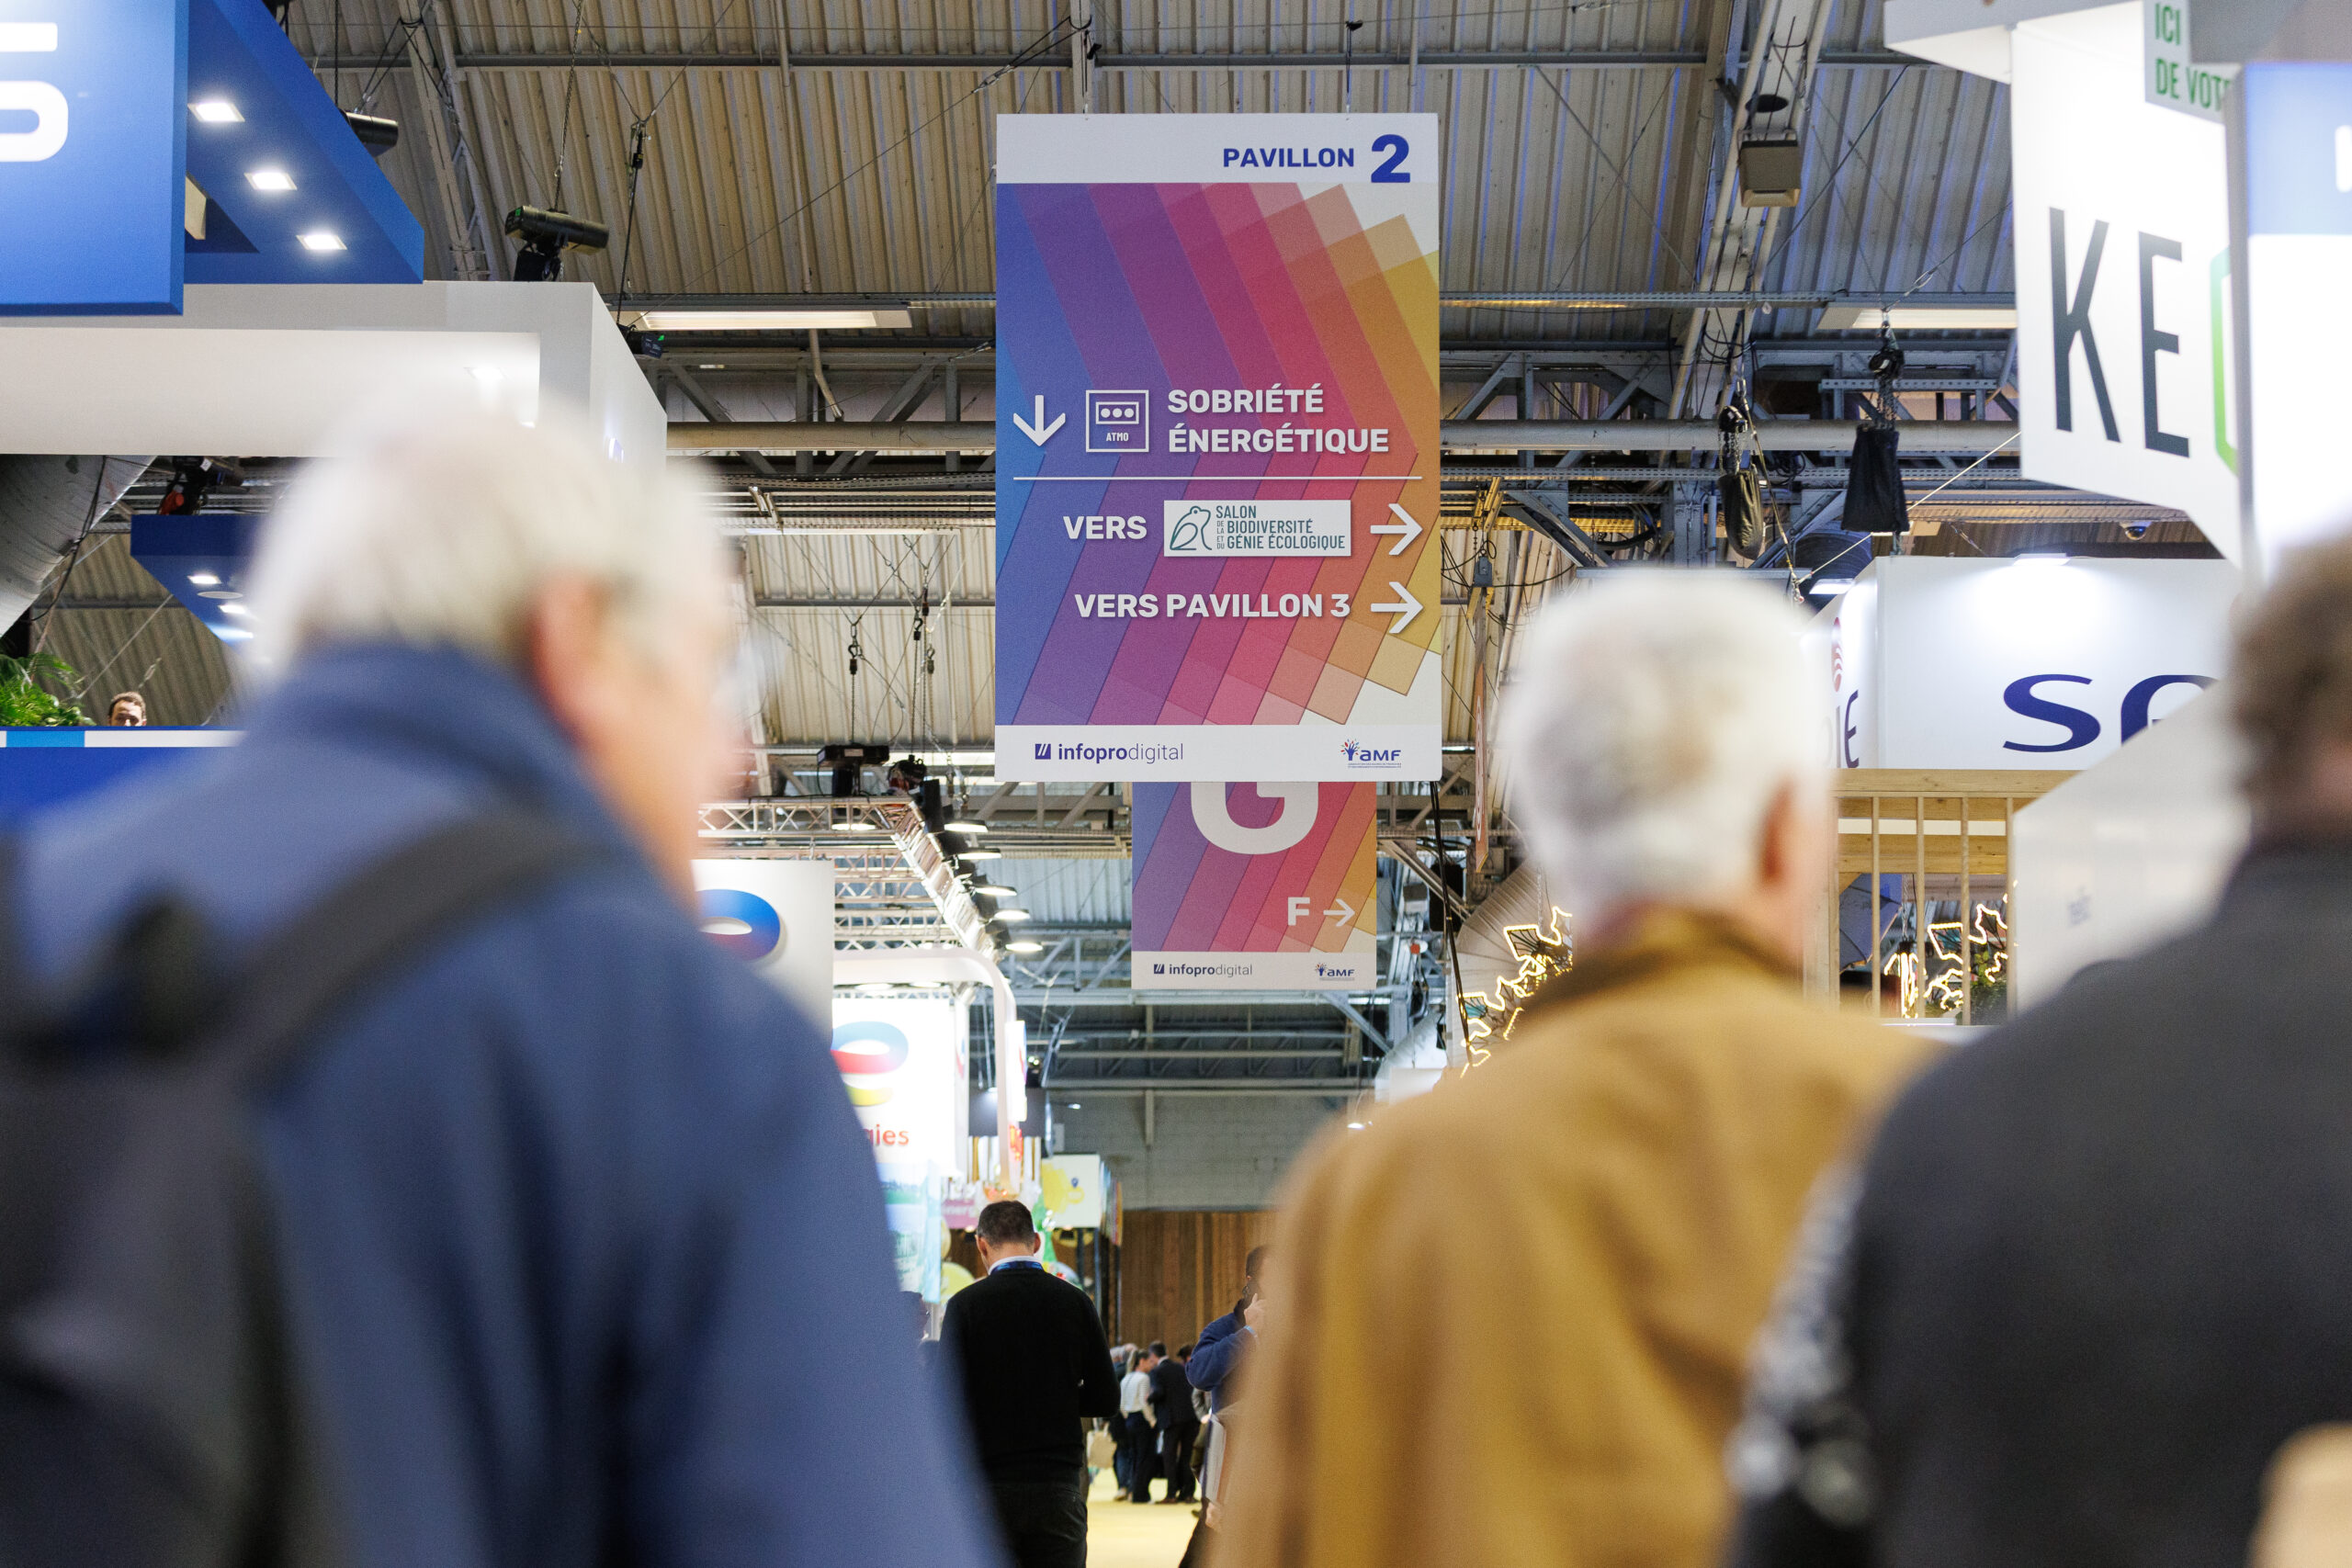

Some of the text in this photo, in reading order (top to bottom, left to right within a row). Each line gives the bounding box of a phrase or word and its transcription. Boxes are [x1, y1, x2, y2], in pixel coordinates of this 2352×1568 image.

[2154, 3, 2181, 46] ICI
[2155, 58, 2231, 111] DE VOT
[1223, 134, 1411, 183] PAVILLON 2
[1168, 382, 1324, 413] SOBRIÉTÉ
[1105, 433, 1129, 442] ATMO
[1169, 423, 1389, 454] ÉNERGÉTIQUE
[1216, 505, 1257, 519] SALON
[1063, 515, 1148, 539] VERS
[1227, 518, 1314, 534] BIODIVERSITÉ
[1227, 534, 1264, 549] GÉNIE
[1268, 534, 1346, 550] ÉCOLOGIQUE
[1074, 593, 1351, 618] VERS PAVILLON 3
[1058, 742, 1183, 764] infoprodigital
[1287, 897, 1311, 926] F
[1169, 964, 1253, 978] infoprodigital
